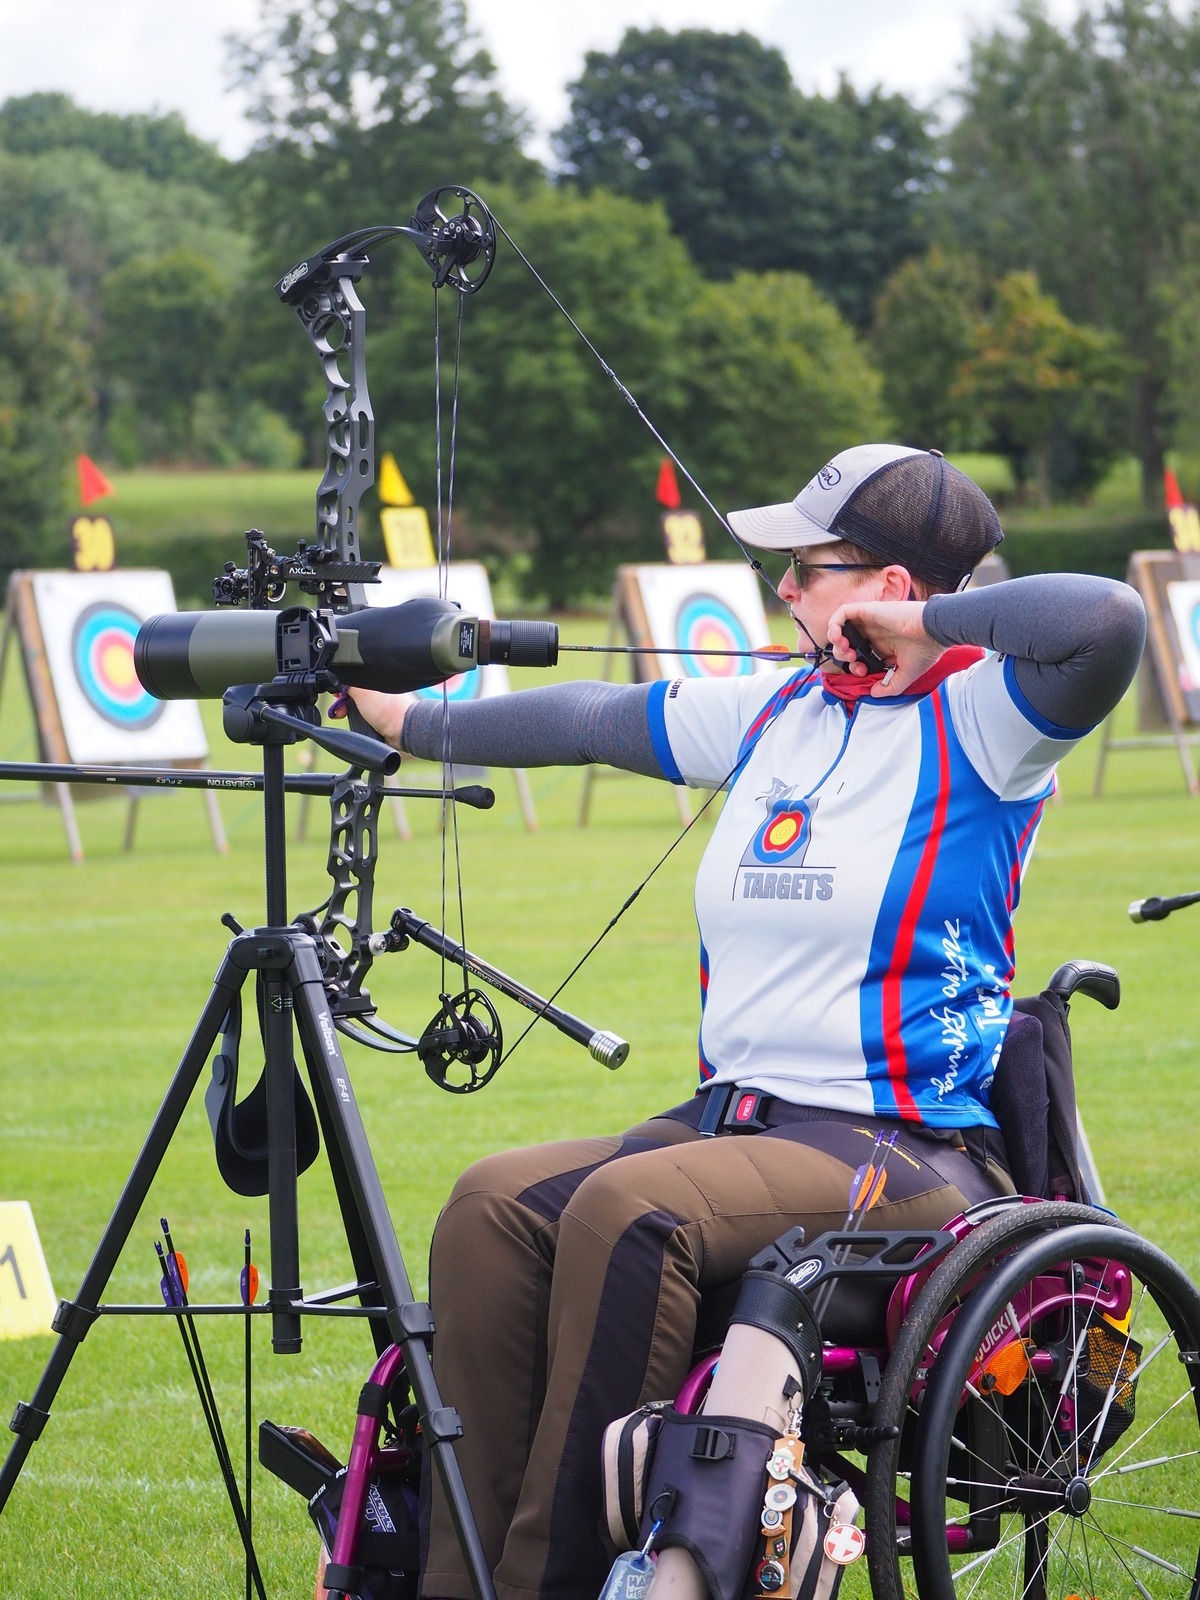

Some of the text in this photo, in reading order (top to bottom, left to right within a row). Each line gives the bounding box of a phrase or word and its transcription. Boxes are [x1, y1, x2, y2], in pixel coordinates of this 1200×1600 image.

[73, 516, 115, 571] 30
[207, 779, 243, 788] EASTON
[742, 872, 834, 901] TARGETS
[318, 1011, 337, 1056] Velbon
[336, 1077, 351, 1103] EF-61
[742, 1099, 753, 1117] PRESS
